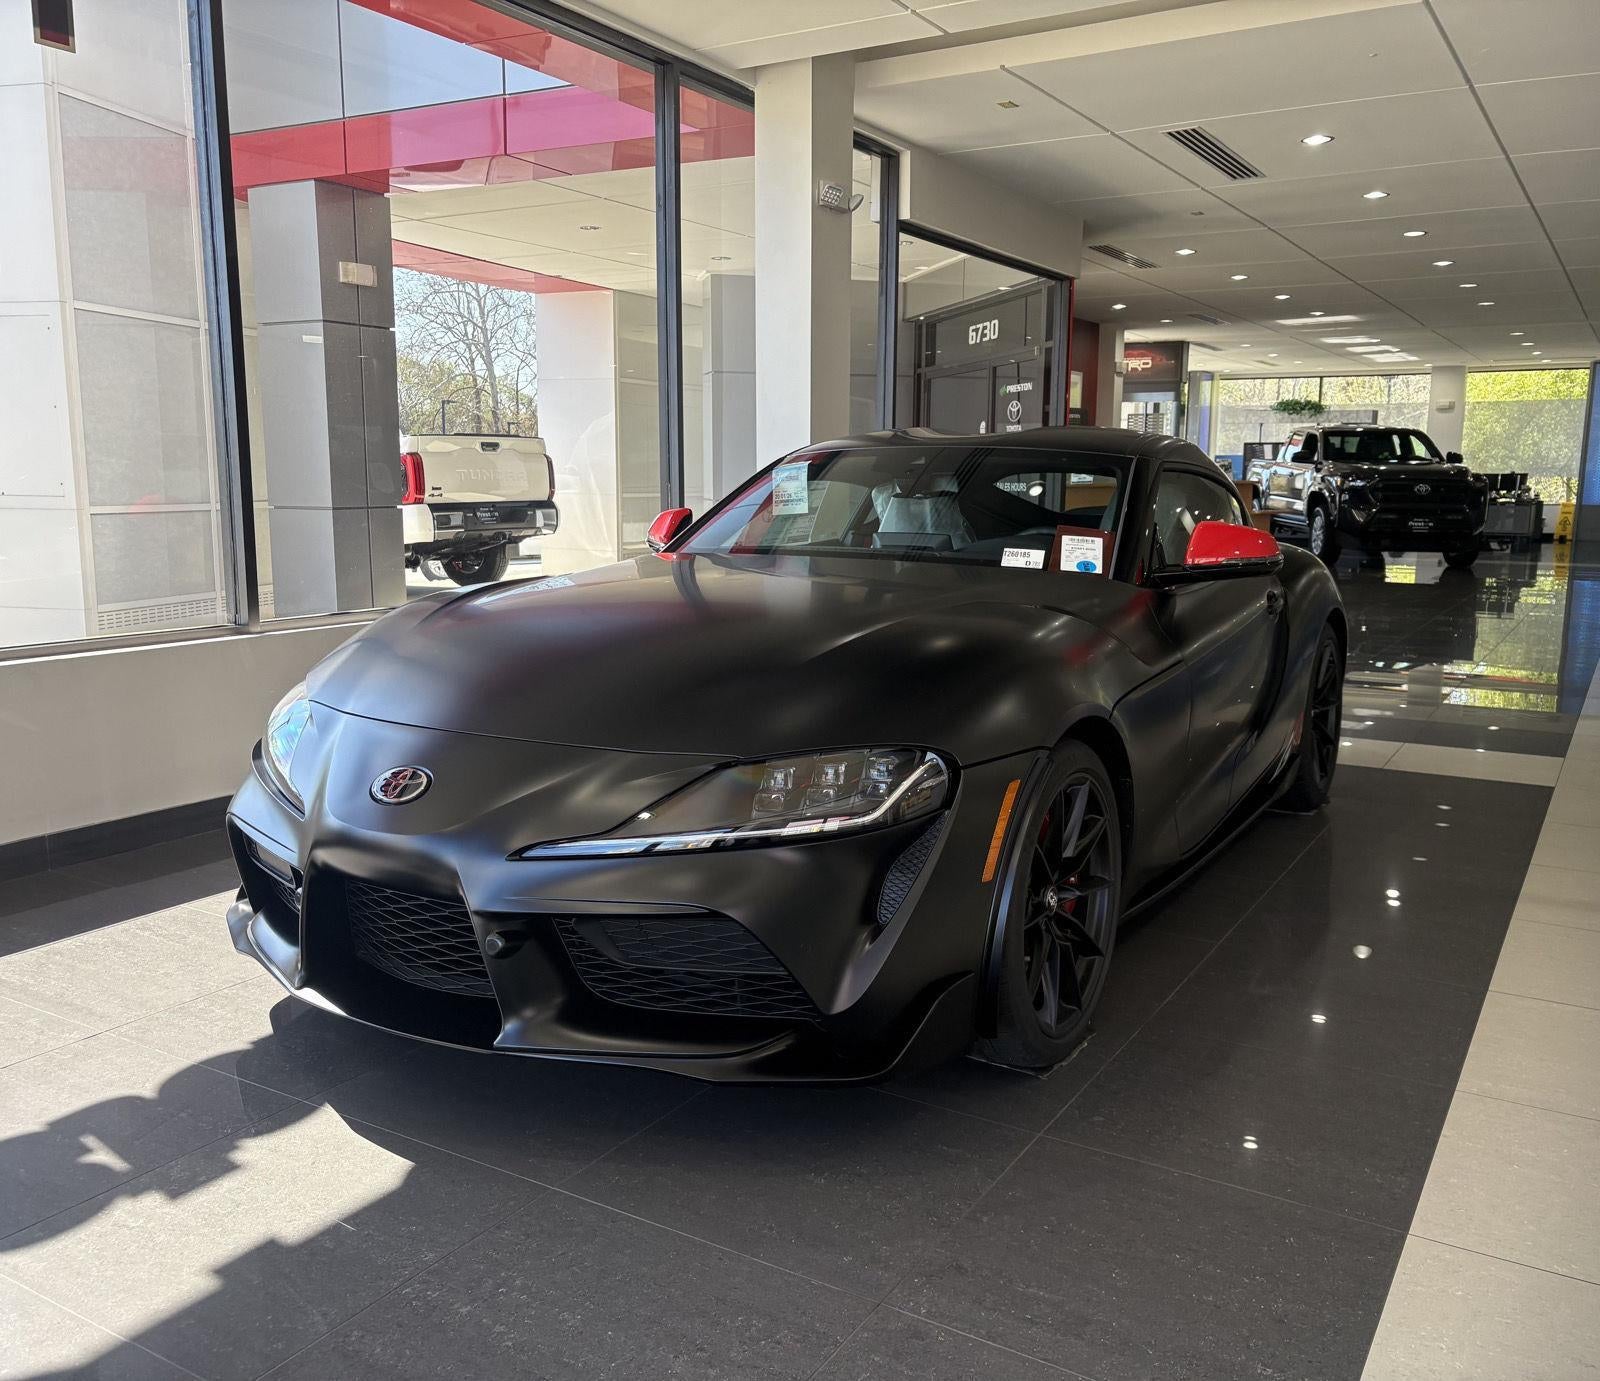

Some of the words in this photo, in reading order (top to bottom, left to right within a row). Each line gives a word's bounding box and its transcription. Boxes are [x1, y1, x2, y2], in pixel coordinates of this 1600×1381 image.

[968, 319, 999, 345] 6730
[1006, 382, 1033, 394] PRESTON
[1010, 482, 1027, 491] HOURS
